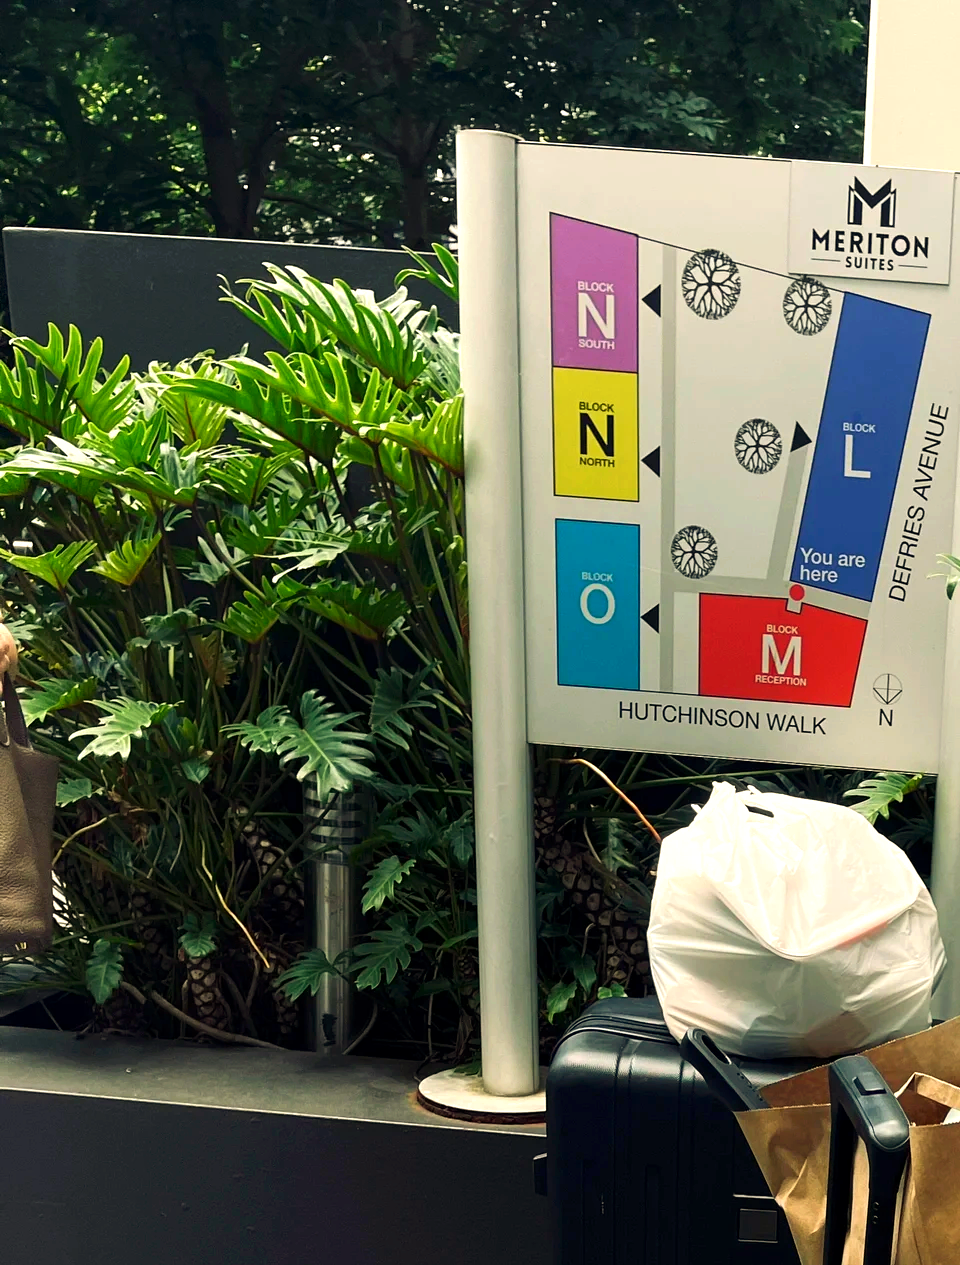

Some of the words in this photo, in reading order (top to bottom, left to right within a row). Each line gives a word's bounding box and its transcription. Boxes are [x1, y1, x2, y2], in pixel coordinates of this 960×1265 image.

[811, 228, 929, 260] MERITON
[845, 256, 894, 271] SUITES
[577, 281, 615, 294] BLOCK
[577, 294, 615, 340] N
[578, 339, 615, 350] SOUTH
[578, 402, 615, 414] BLOCK
[579, 413, 615, 457] N
[842, 422, 876, 434] BLOCK
[579, 456, 615, 468] NORTH
[843, 435, 871, 479] L
[888, 505, 926, 602] DEFRIES
[912, 403, 949, 501] AVENUE
[800, 547, 833, 569] You
[837, 553, 866, 569] are
[581, 571, 614, 582] BLOCK
[800, 566, 838, 583] here
[579, 582, 616, 625] O
[766, 624, 799, 635] BLOCK
[761, 634, 802, 677] M
[755, 674, 807, 687] RECEPTION
[618, 701, 760, 730] HUTCHINSON
[766, 713, 827, 735] WALK
[878, 708, 894, 728] N
